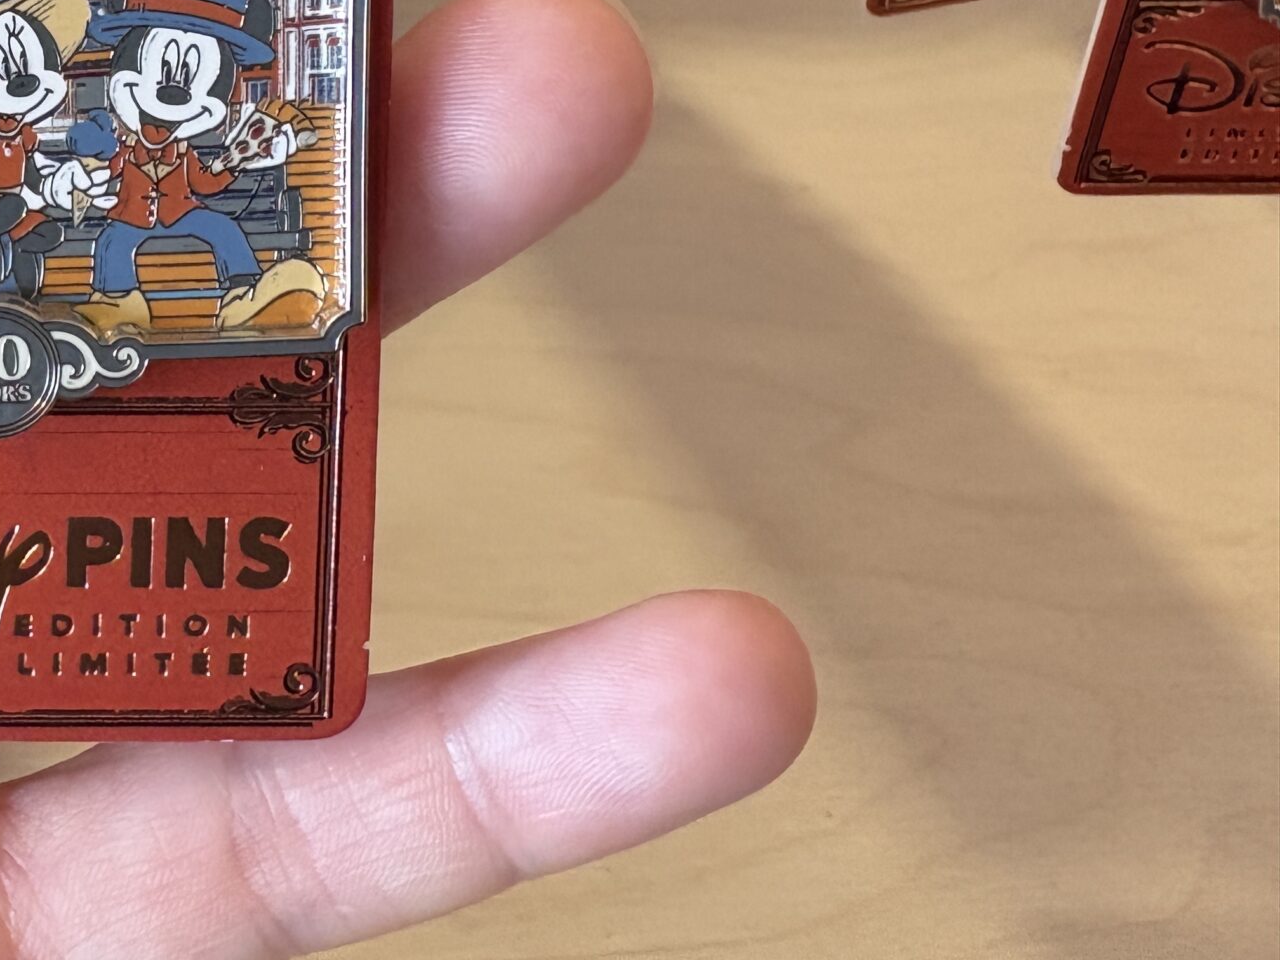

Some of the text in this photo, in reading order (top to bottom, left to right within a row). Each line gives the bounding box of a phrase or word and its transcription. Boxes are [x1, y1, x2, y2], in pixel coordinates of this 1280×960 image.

[67, 516, 292, 589] PINS
[14, 612, 251, 638] EDITION
[19, 647, 248, 676] LIMITÉE
